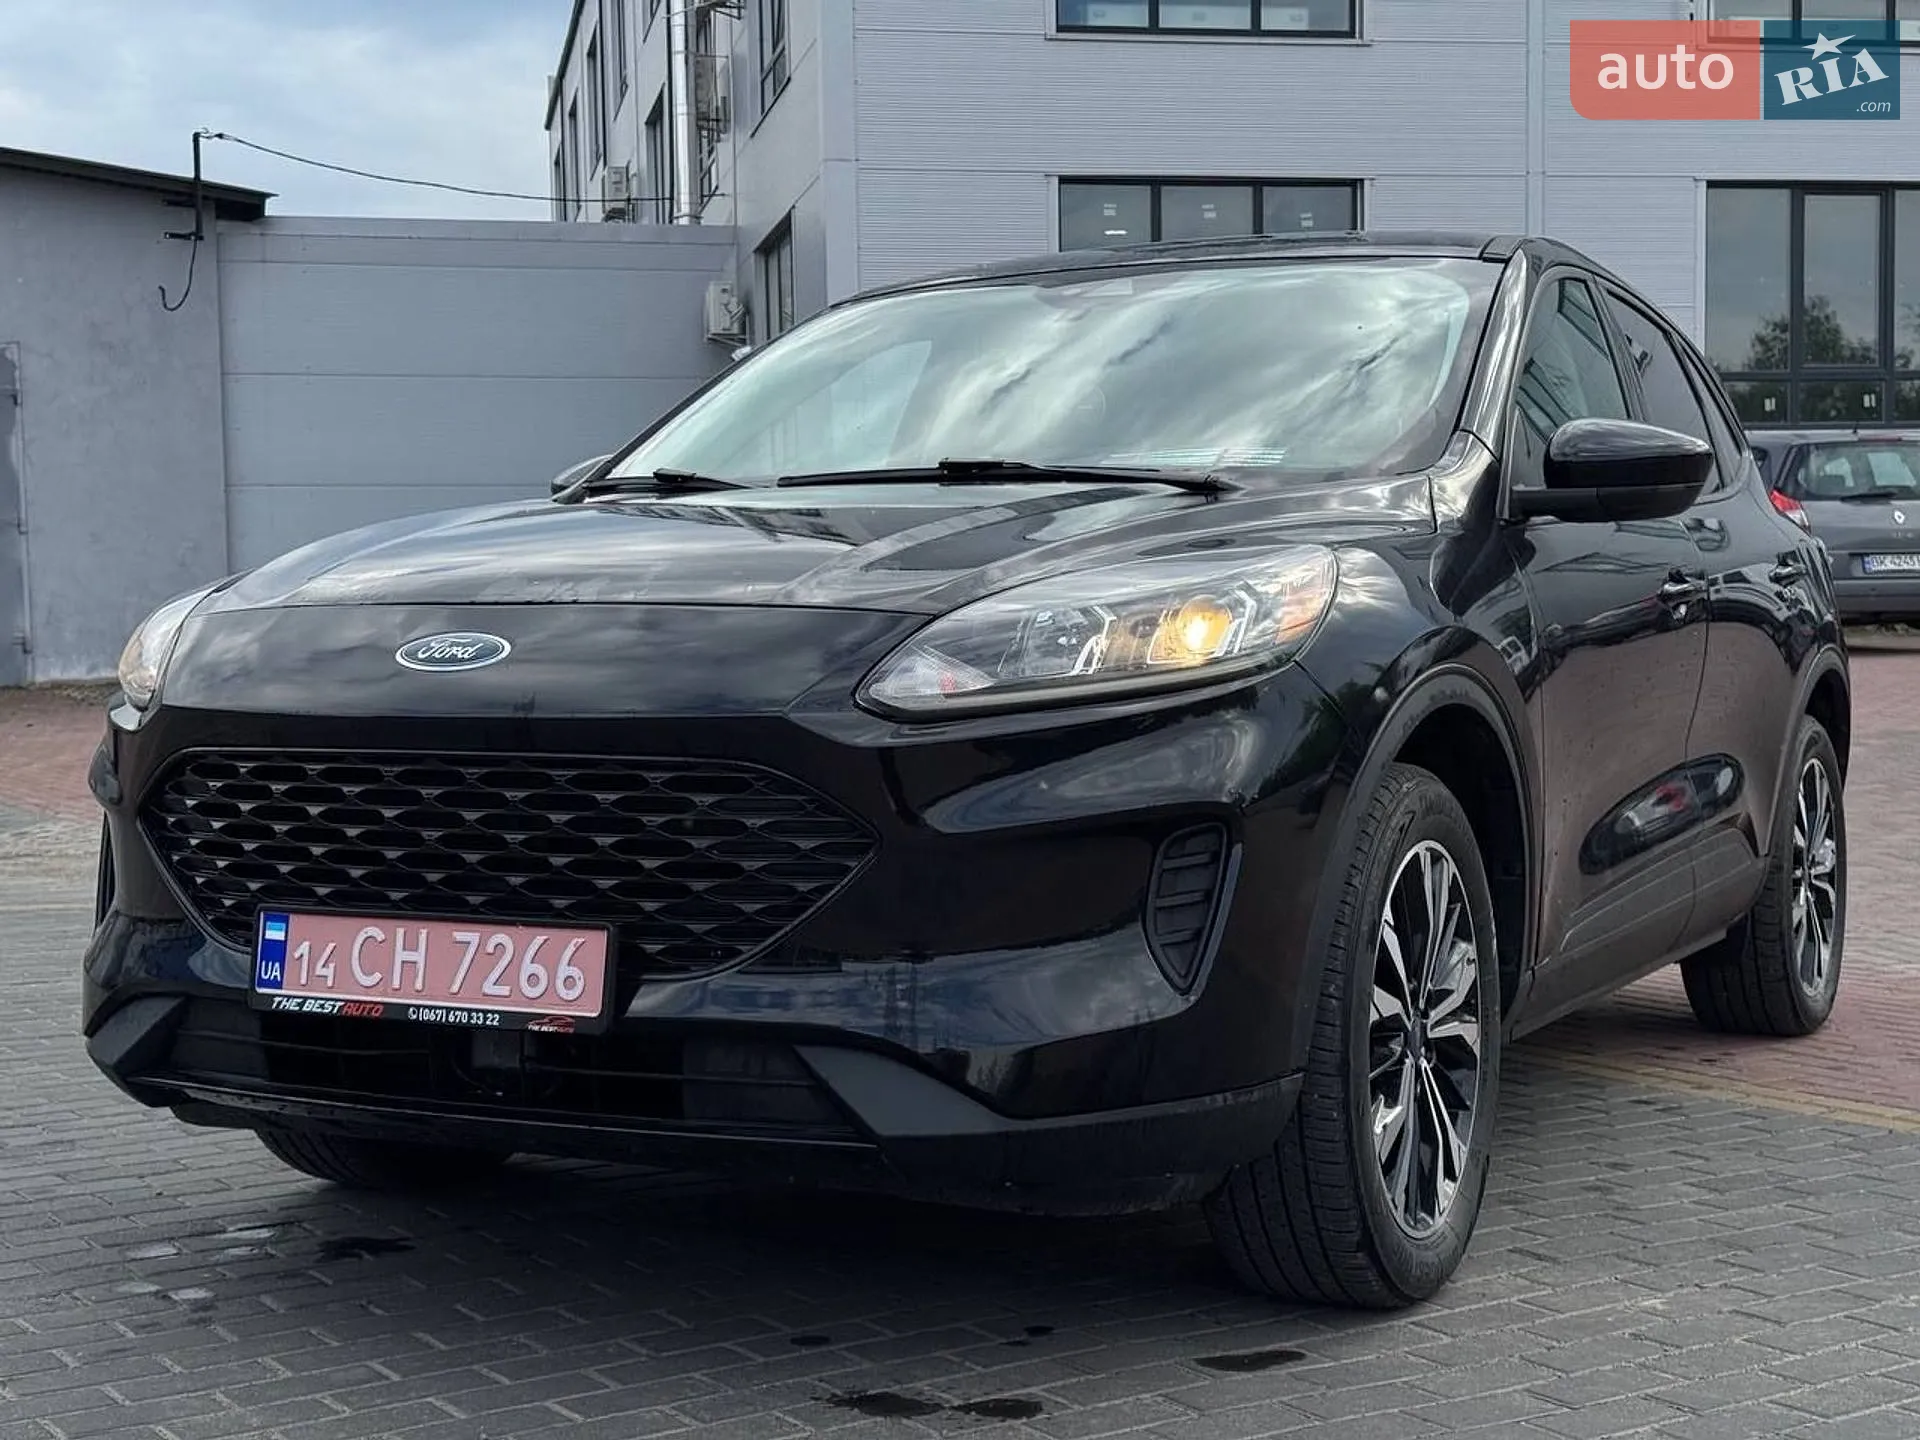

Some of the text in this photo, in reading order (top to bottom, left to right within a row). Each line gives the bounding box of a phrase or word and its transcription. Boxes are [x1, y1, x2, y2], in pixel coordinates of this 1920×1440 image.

[417, 637, 484, 659] Ford
[260, 960, 281, 982] UA
[293, 926, 587, 1001] 14 CH 7266
[271, 996, 303, 1010] THE
[418, 1007, 500, 1026] (067) 670 33 22
